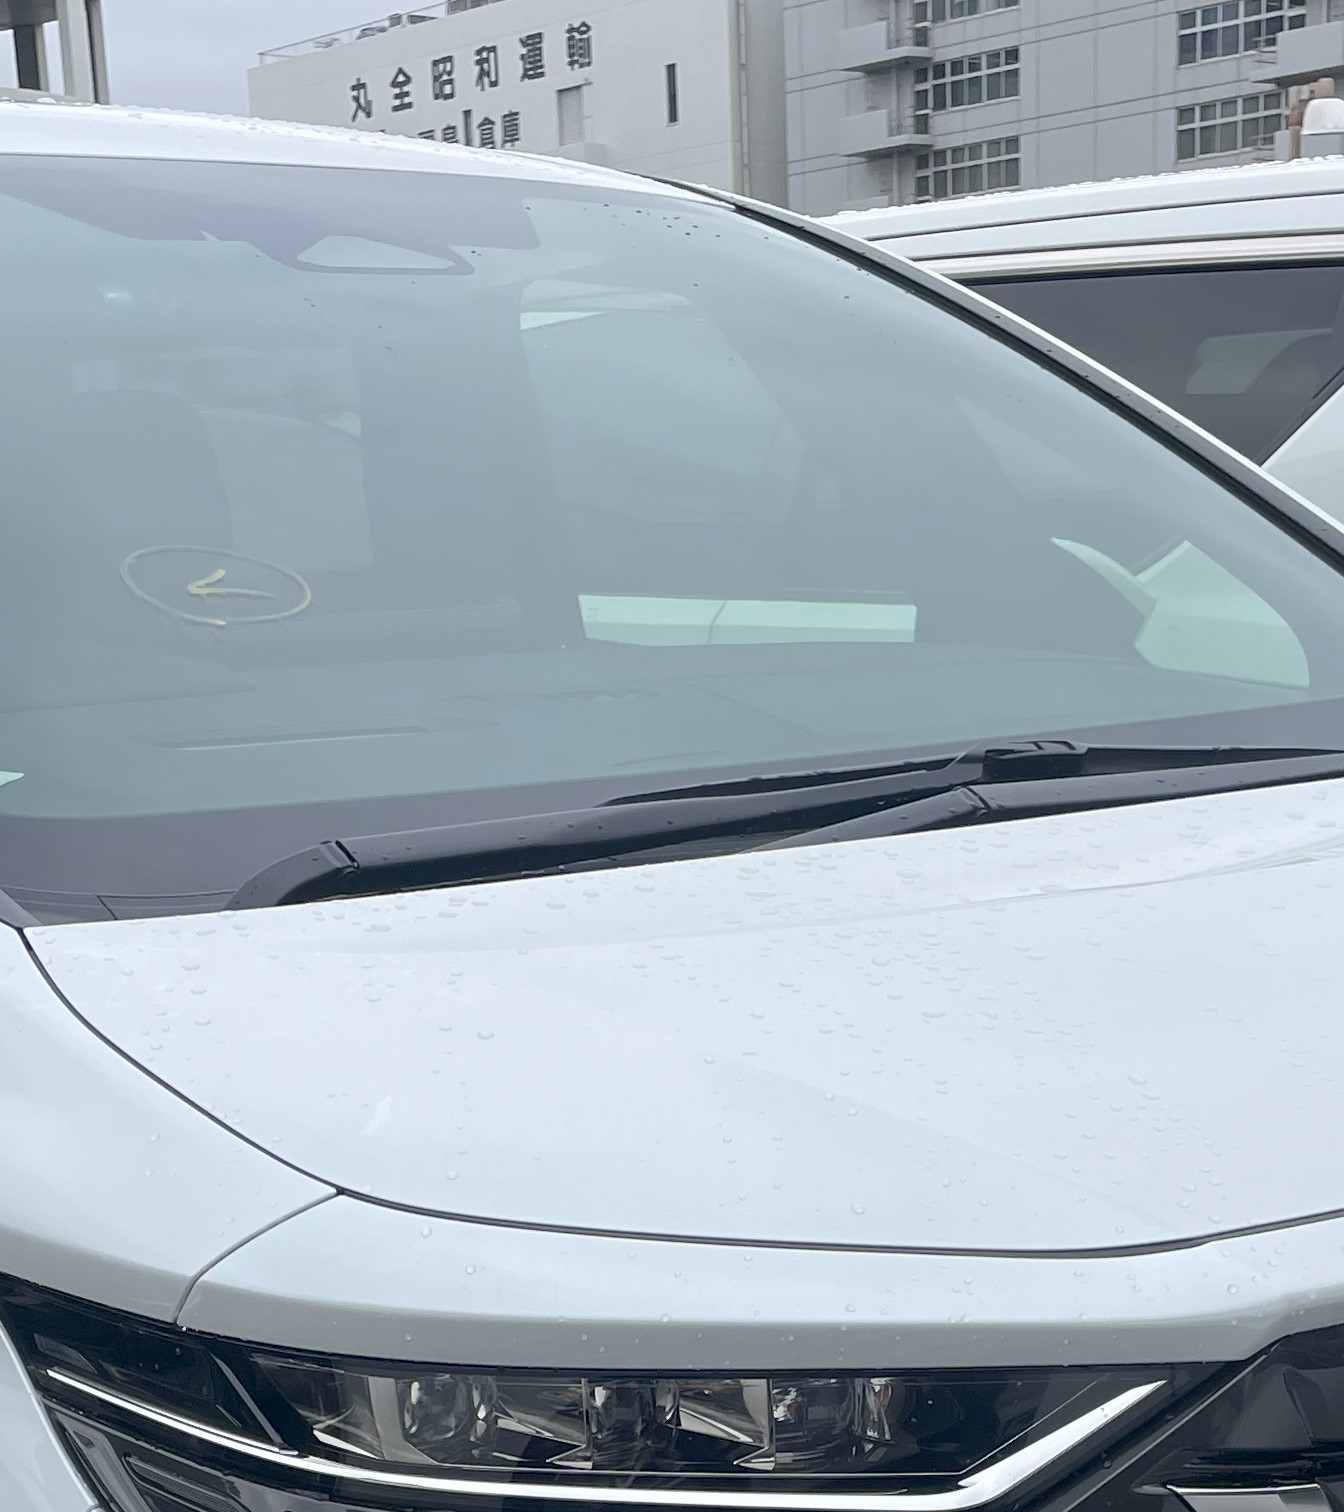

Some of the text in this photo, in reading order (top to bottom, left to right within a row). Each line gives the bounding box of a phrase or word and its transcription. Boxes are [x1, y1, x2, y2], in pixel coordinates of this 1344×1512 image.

[350, 21, 593, 122] 丸全昭和運輸
